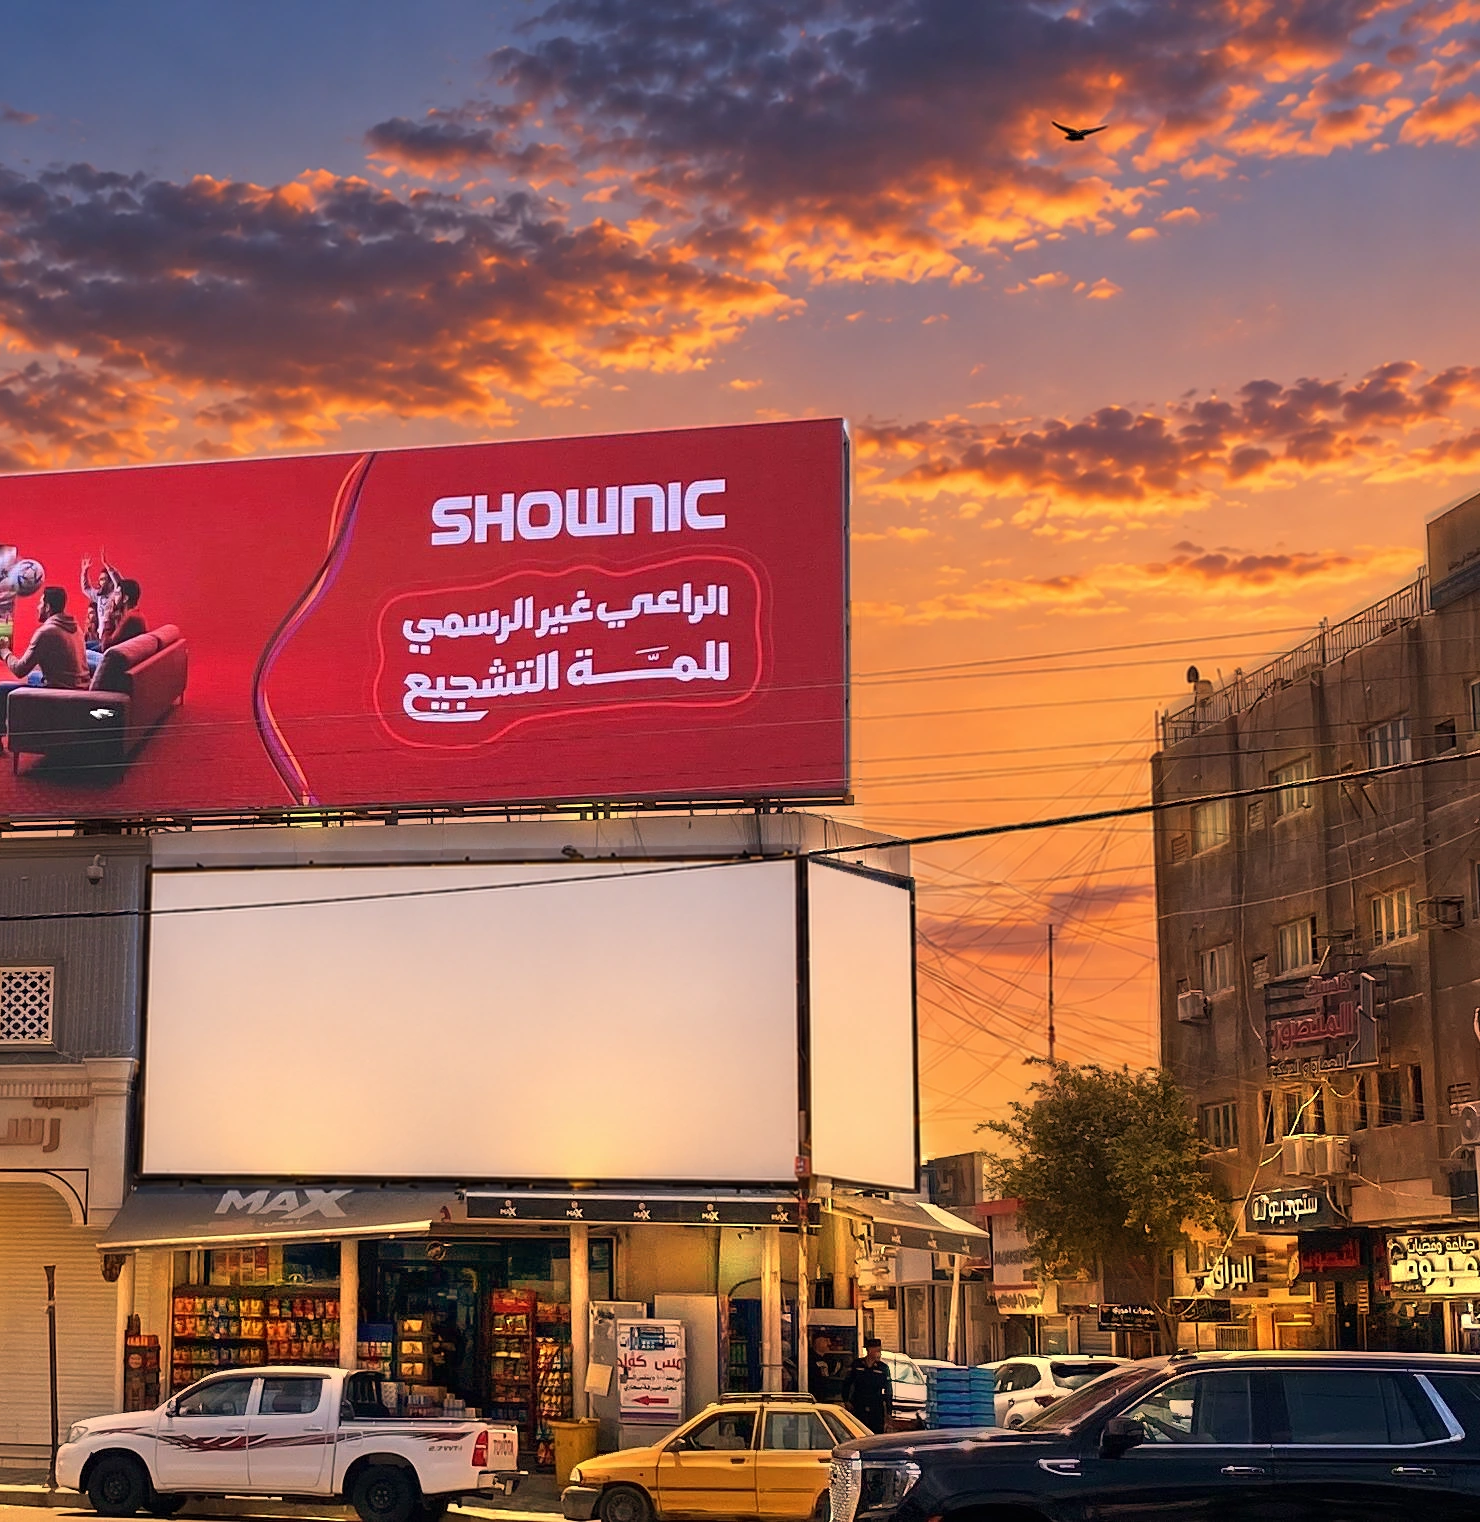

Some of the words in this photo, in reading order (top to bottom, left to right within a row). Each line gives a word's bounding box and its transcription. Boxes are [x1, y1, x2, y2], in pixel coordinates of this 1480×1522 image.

[431, 478, 727, 546] SHOWNIC
[402, 595, 534, 655] الرسمي
[535, 589, 593, 639] غير
[596, 582, 729, 629] الراعي
[401, 648, 561, 723] التشجيع
[214, 1188, 355, 1219] MAX
